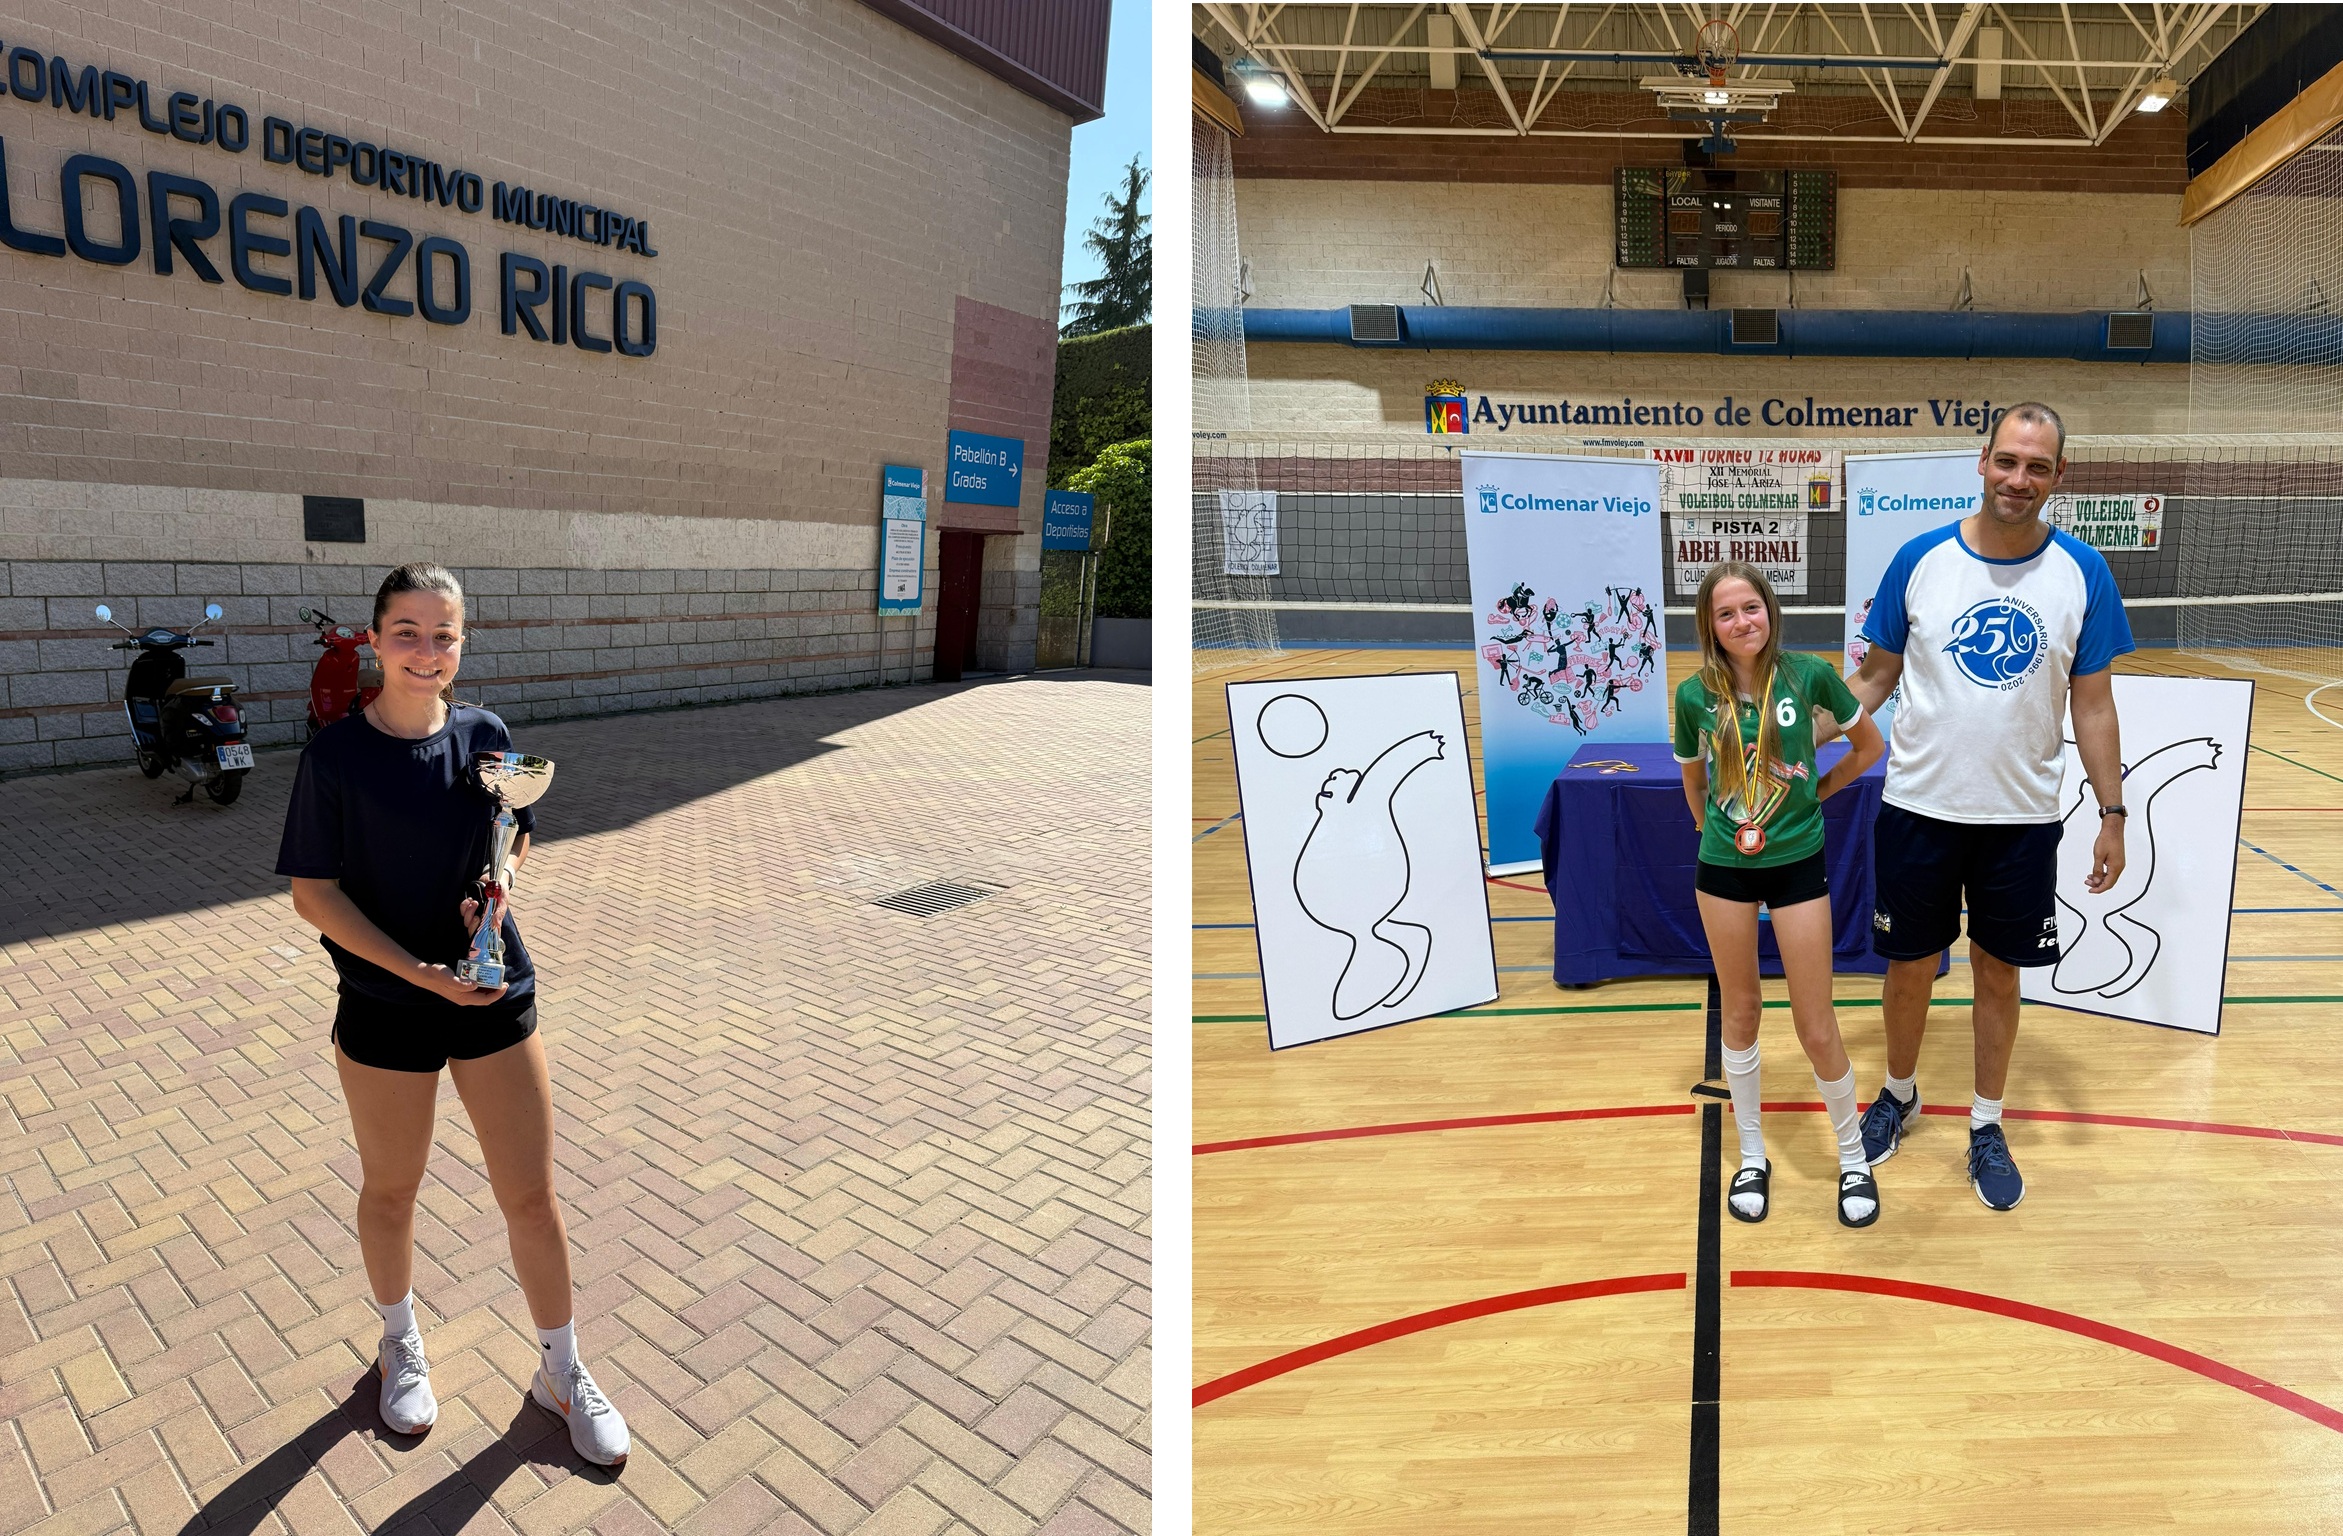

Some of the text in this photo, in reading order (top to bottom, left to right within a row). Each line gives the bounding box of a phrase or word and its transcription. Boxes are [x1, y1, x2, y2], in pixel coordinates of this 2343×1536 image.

[0, 40, 658, 257] OMPLEJO DEPORTIVO MUNICIPAL
[1671, 197, 1702, 206] LOCAL
[1749, 198, 1780, 208] VISITANTE
[1715, 224, 1738, 232] PERIODO
[0, 136, 657, 357] LORENZO RICO
[1676, 257, 1698, 265] FALTAS
[1473, 395, 1704, 430] Ayuntamiento
[1714, 396, 1751, 426] de
[1761, 396, 1918, 426] Colmenar
[1583, 438, 1644, 448] www.fmvoley.com
[954, 444, 1007, 467] Pabellón B
[1701, 450, 1752, 464] TORNEO
[1779, 450, 1822, 464] HORAS
[1709, 467, 1724, 476] XII
[952, 471, 987, 490] Gradas
[1734, 477, 1745, 488] A.
[1051, 500, 1087, 516] Acceso a
[1501, 493, 1651, 517] Colmenar Viejo
[1679, 493, 1799, 509] VOLEIBOL COLMENAR
[1877, 494, 1976, 512] Colmenar
[2076, 500, 2136, 521] VOLEIBOL
[1045, 522, 1089, 539] Deportistas
[1712, 521, 1779, 534] PISTA 2
[2072, 525, 2140, 546] COLMENAR
[1677, 540, 1802, 563] ABEL BERNAL
[2003, 595, 2048, 650] ANIVERSARIO
[1942, 615, 2010, 656] 25
[2028, 652, 2045, 675] 1995
[2001, 677, 2025, 691] 2020
[1776, 697, 1797, 727] 6
[225, 745, 249, 757] 0548
[1740, 1170, 1758, 1179] NIKE
[1845, 1174, 1864, 1184] NIKE
